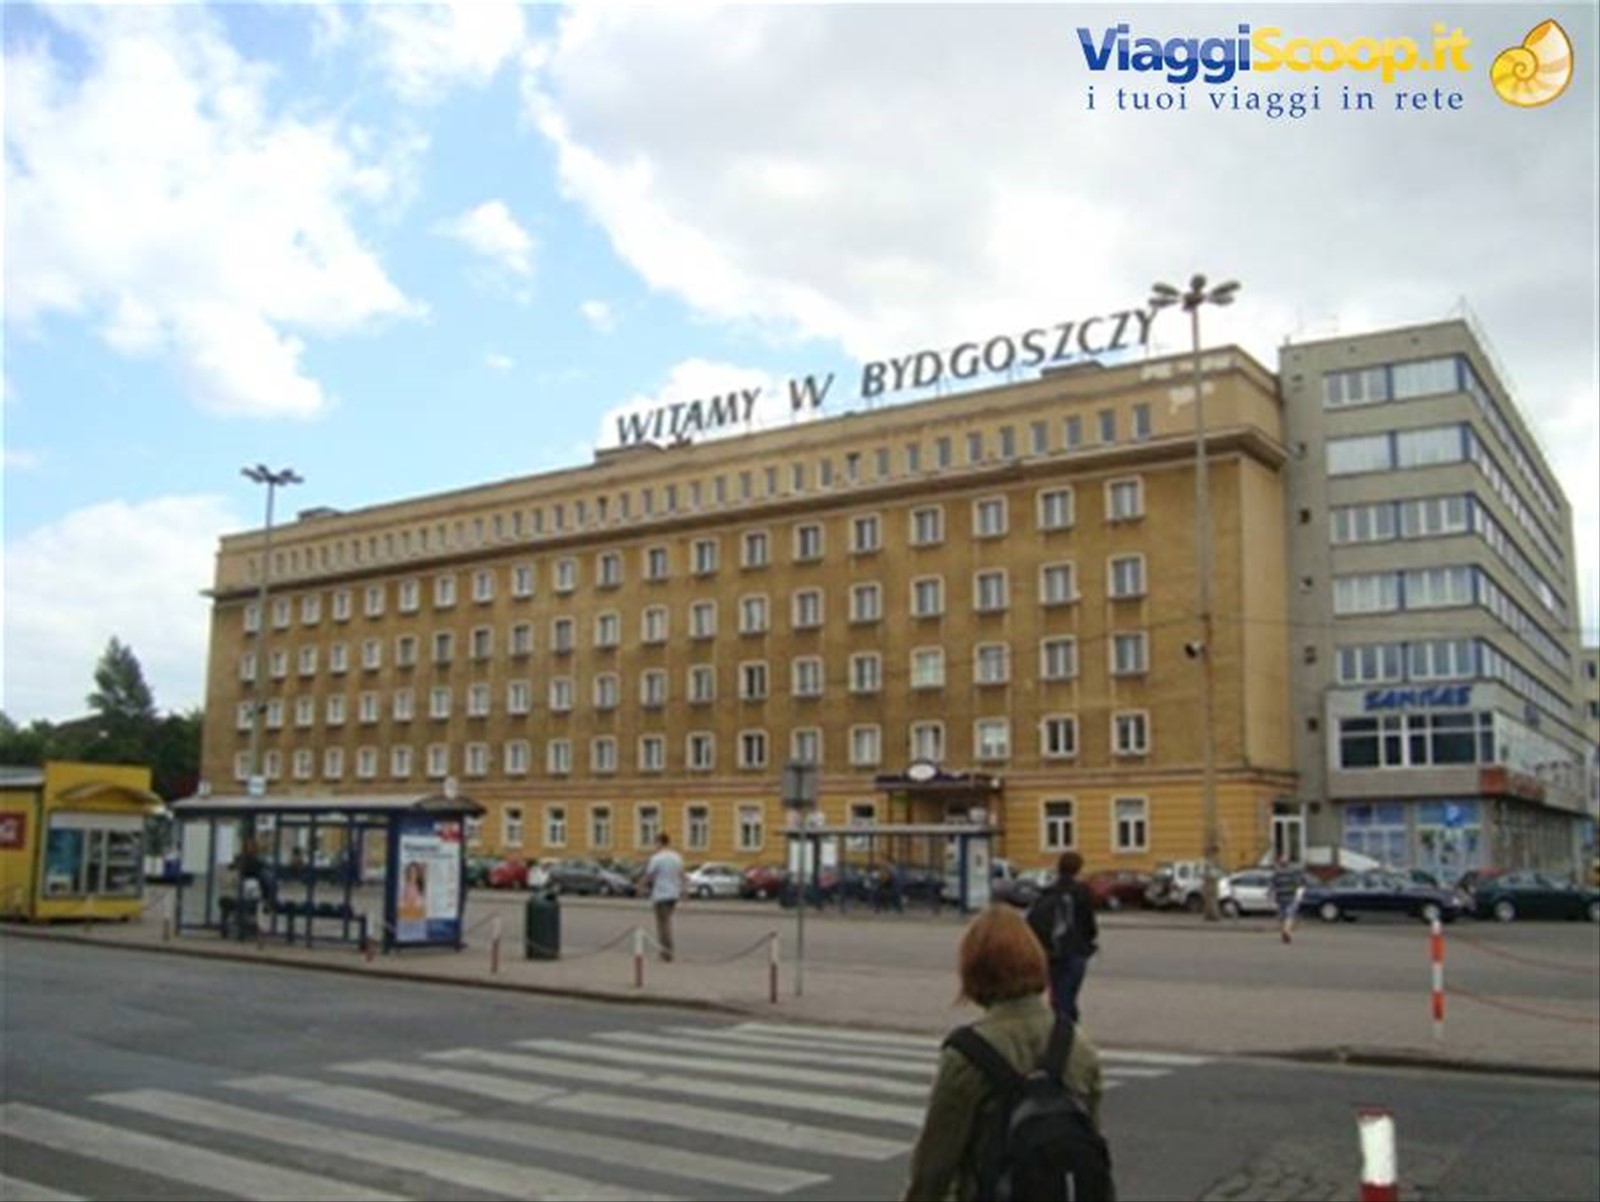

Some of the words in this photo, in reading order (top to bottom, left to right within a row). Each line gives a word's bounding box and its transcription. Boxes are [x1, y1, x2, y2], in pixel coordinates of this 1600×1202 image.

[616, 387, 762, 446] WITAMY
[788, 373, 835, 411] W
[860, 308, 1159, 398] BYDGOSZCZY
